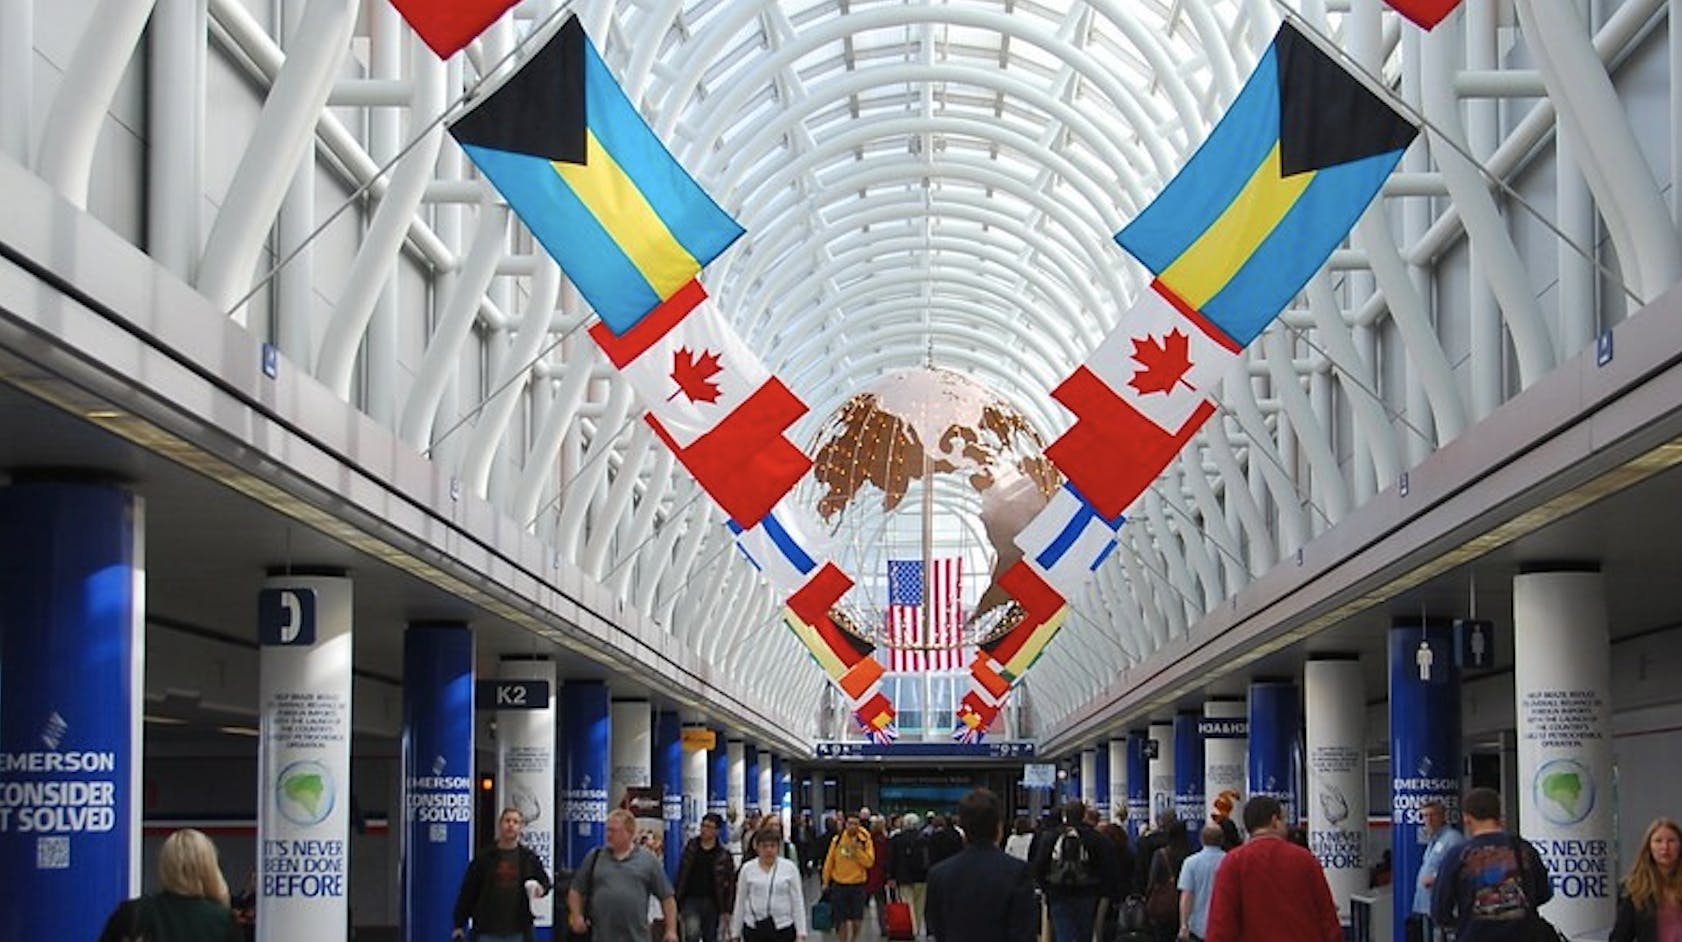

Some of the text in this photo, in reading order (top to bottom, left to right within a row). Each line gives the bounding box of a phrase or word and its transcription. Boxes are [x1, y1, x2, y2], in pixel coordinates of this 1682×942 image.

[497, 686, 526, 704] K2
[0, 807, 115, 832] T SOLVED
[292, 840, 342, 856] NEVER
[1552, 841, 1606, 856] NEVER
[264, 858, 342, 873] BEEN DONE
[1565, 858, 1607, 873] DONE
[263, 874, 342, 897] BEFORE
[1549, 874, 1609, 898] FORE
